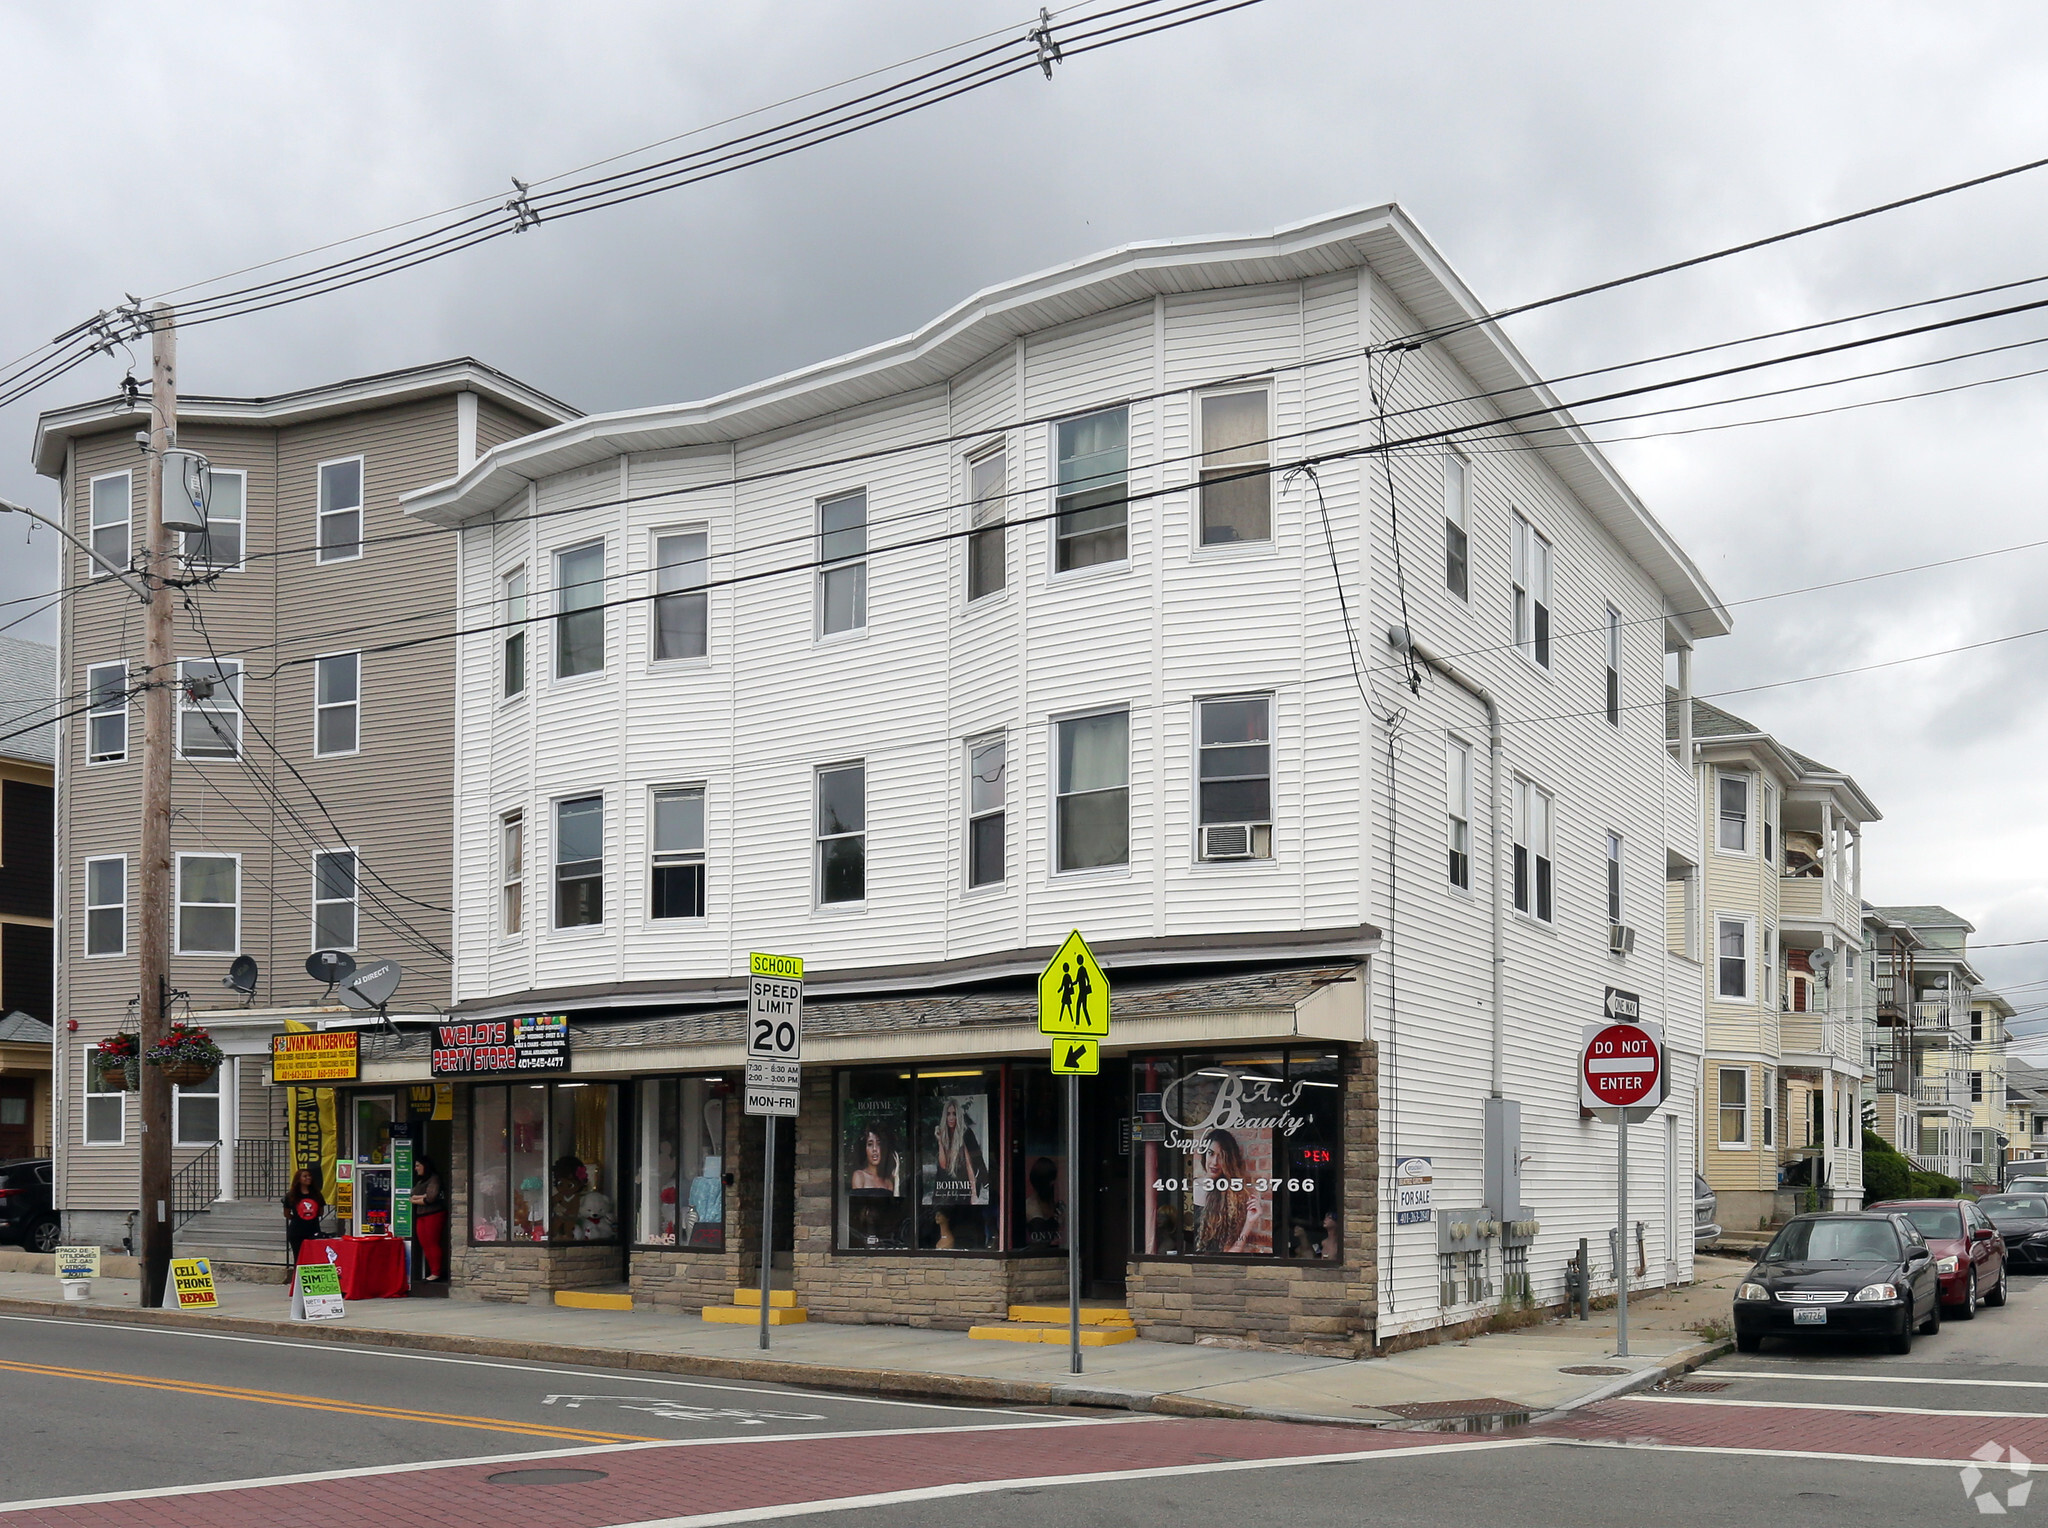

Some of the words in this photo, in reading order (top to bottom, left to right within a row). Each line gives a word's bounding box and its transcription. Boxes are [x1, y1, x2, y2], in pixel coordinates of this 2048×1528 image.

[754, 956, 799, 975] SCHOOL
[362, 965, 390, 983] DIRECTV
[754, 983, 799, 999] SPEED
[757, 999, 793, 1014] LIMIT
[1615, 998, 1625, 1012] ONE
[1625, 1001, 1636, 1015] WAY
[306, 1033, 357, 1051] MULTISERVICES
[753, 1019, 796, 1053] 20
[1595, 1041, 1613, 1054] DO
[1622, 1040, 1648, 1053] NOT
[748, 1063, 762, 1072] 7:30
[788, 1066, 798, 1074] AM
[771, 1075, 785, 1083] 3:00
[1599, 1077, 1642, 1090] ENTER
[749, 1095, 796, 1108] MON-FRI
[1162, 1067, 1305, 1137] Beauty
[298, 1110, 308, 1170] ESTERN
[308, 1111, 320, 1162] UNION
[1164, 1127, 1214, 1155] Supply
[372, 1174, 391, 1191] vig
[936, 1180, 973, 1190] BOHYME
[1152, 1178, 1315, 1192] 401-305-3766
[1401, 1191, 1414, 1206] FOR
[1415, 1190, 1430, 1205] SALE
[174, 1266, 198, 1277] CELL
[301, 1273, 337, 1284] SIMPLE
[176, 1278, 213, 1289] PHONE
[179, 1292, 216, 1303] REPAIR
